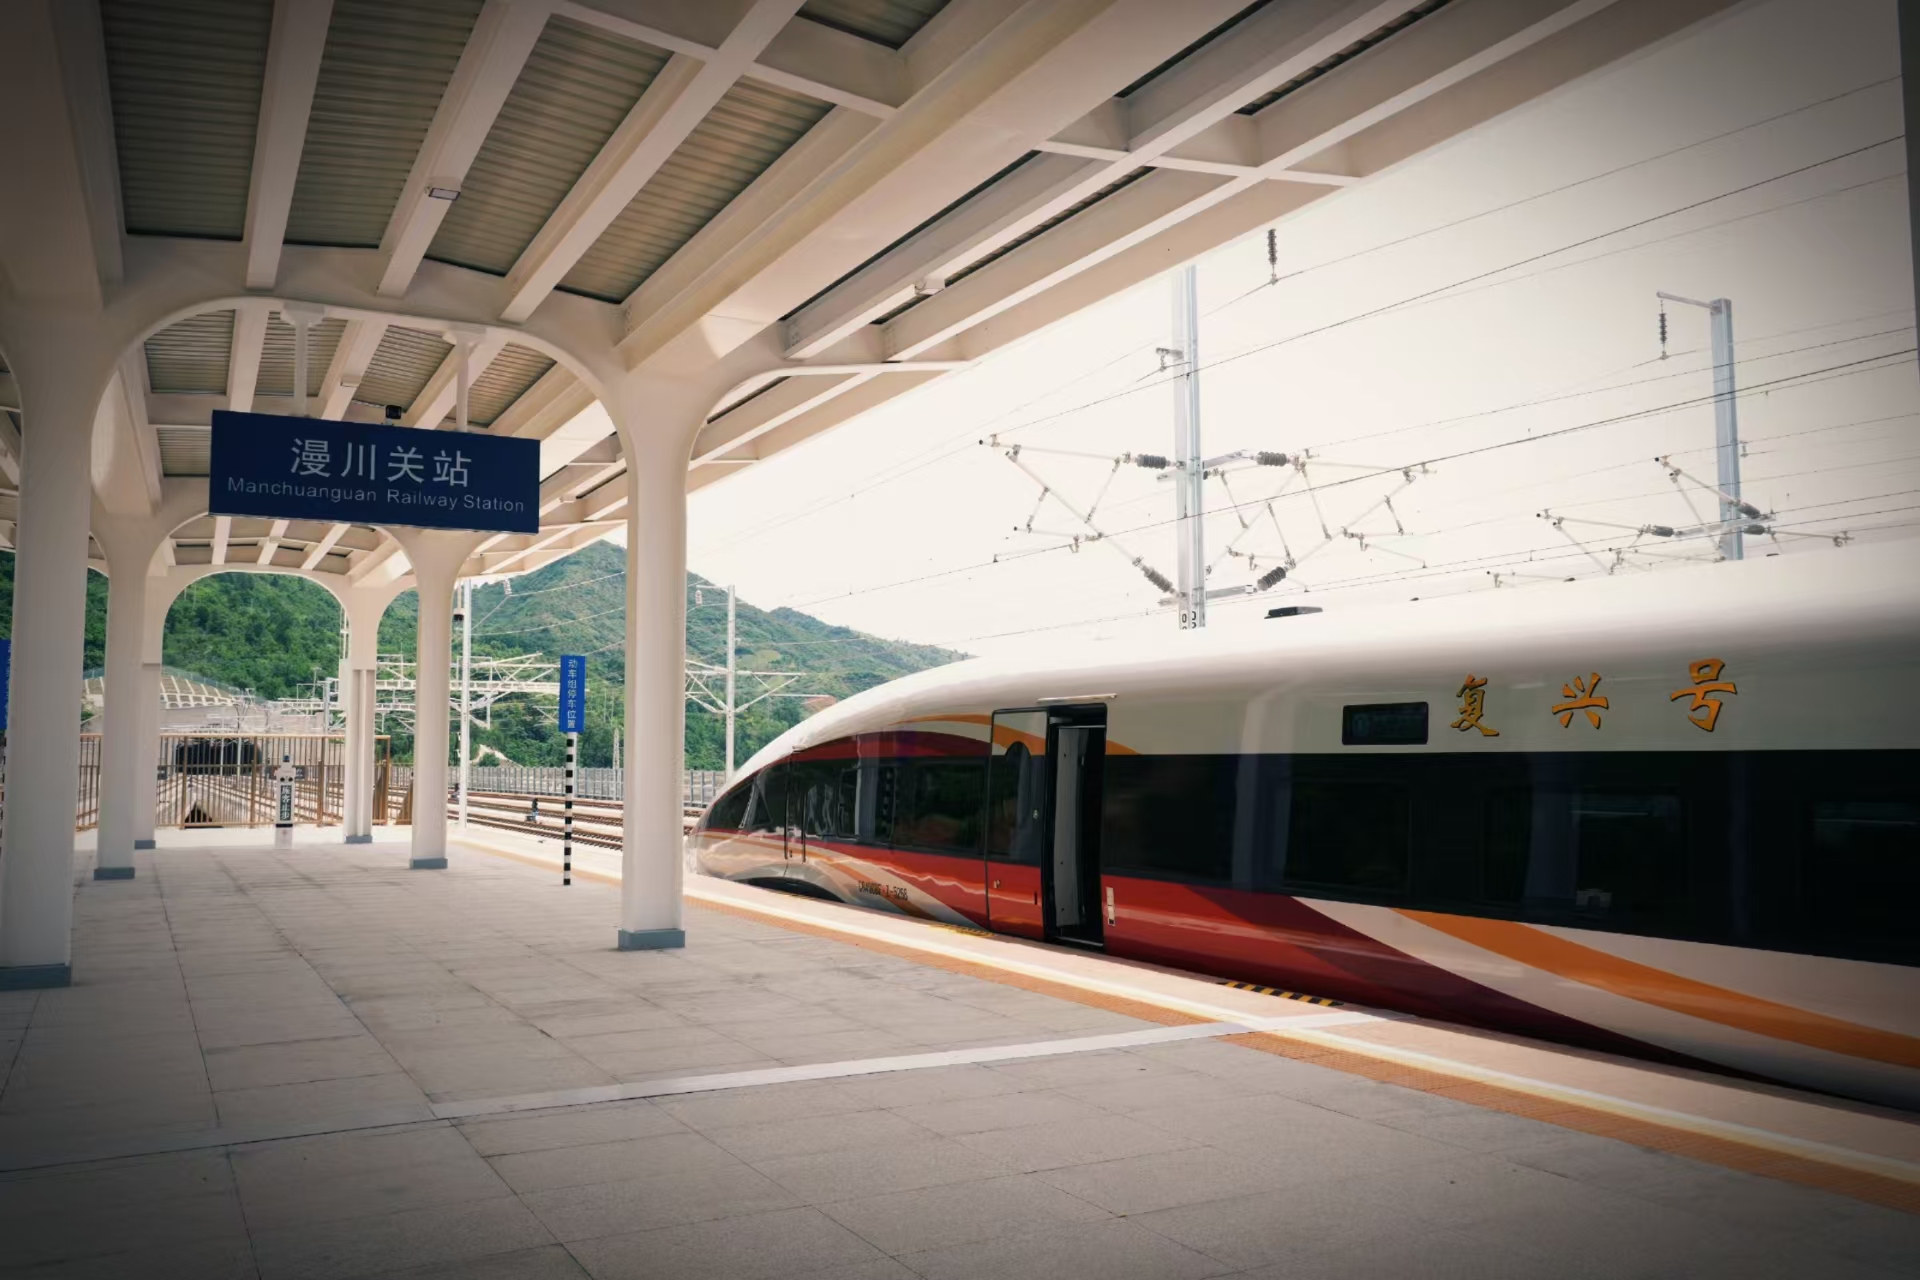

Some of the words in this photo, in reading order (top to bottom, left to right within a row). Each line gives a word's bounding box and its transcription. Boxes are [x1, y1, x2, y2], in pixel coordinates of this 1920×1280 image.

[290, 437, 472, 488] 漫川关站
[227, 476, 377, 503] Manchuanguan
[387, 488, 457, 510] Railway
[463, 494, 524, 513] Station
[567, 659, 578, 729] 动车组停车位置
[1451, 657, 1738, 736] 复兴号
